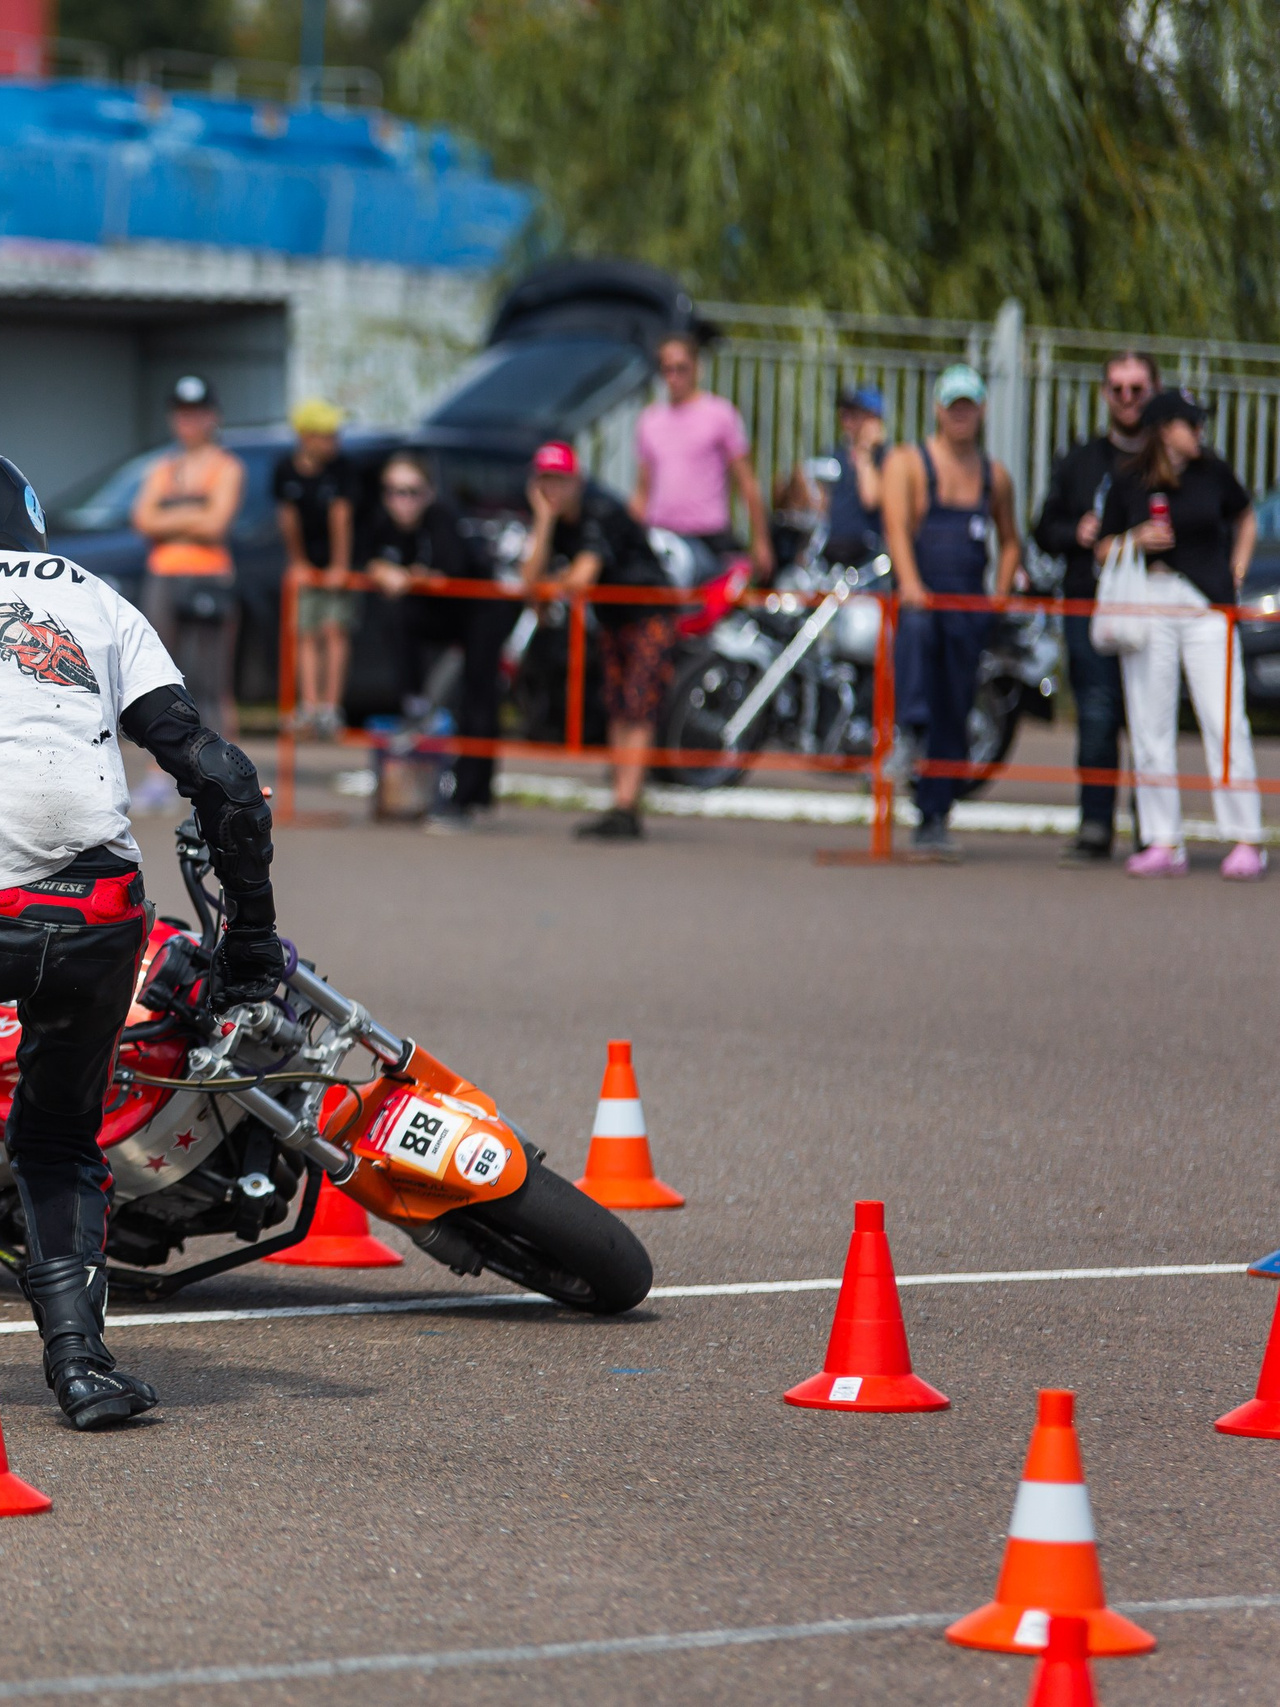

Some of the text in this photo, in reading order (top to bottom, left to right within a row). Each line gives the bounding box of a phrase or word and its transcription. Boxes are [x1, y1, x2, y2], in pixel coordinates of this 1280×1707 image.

[25, 880, 86, 894] AINESE
[399, 1111, 443, 1157] 88
[475, 1148, 497, 1176] 88
